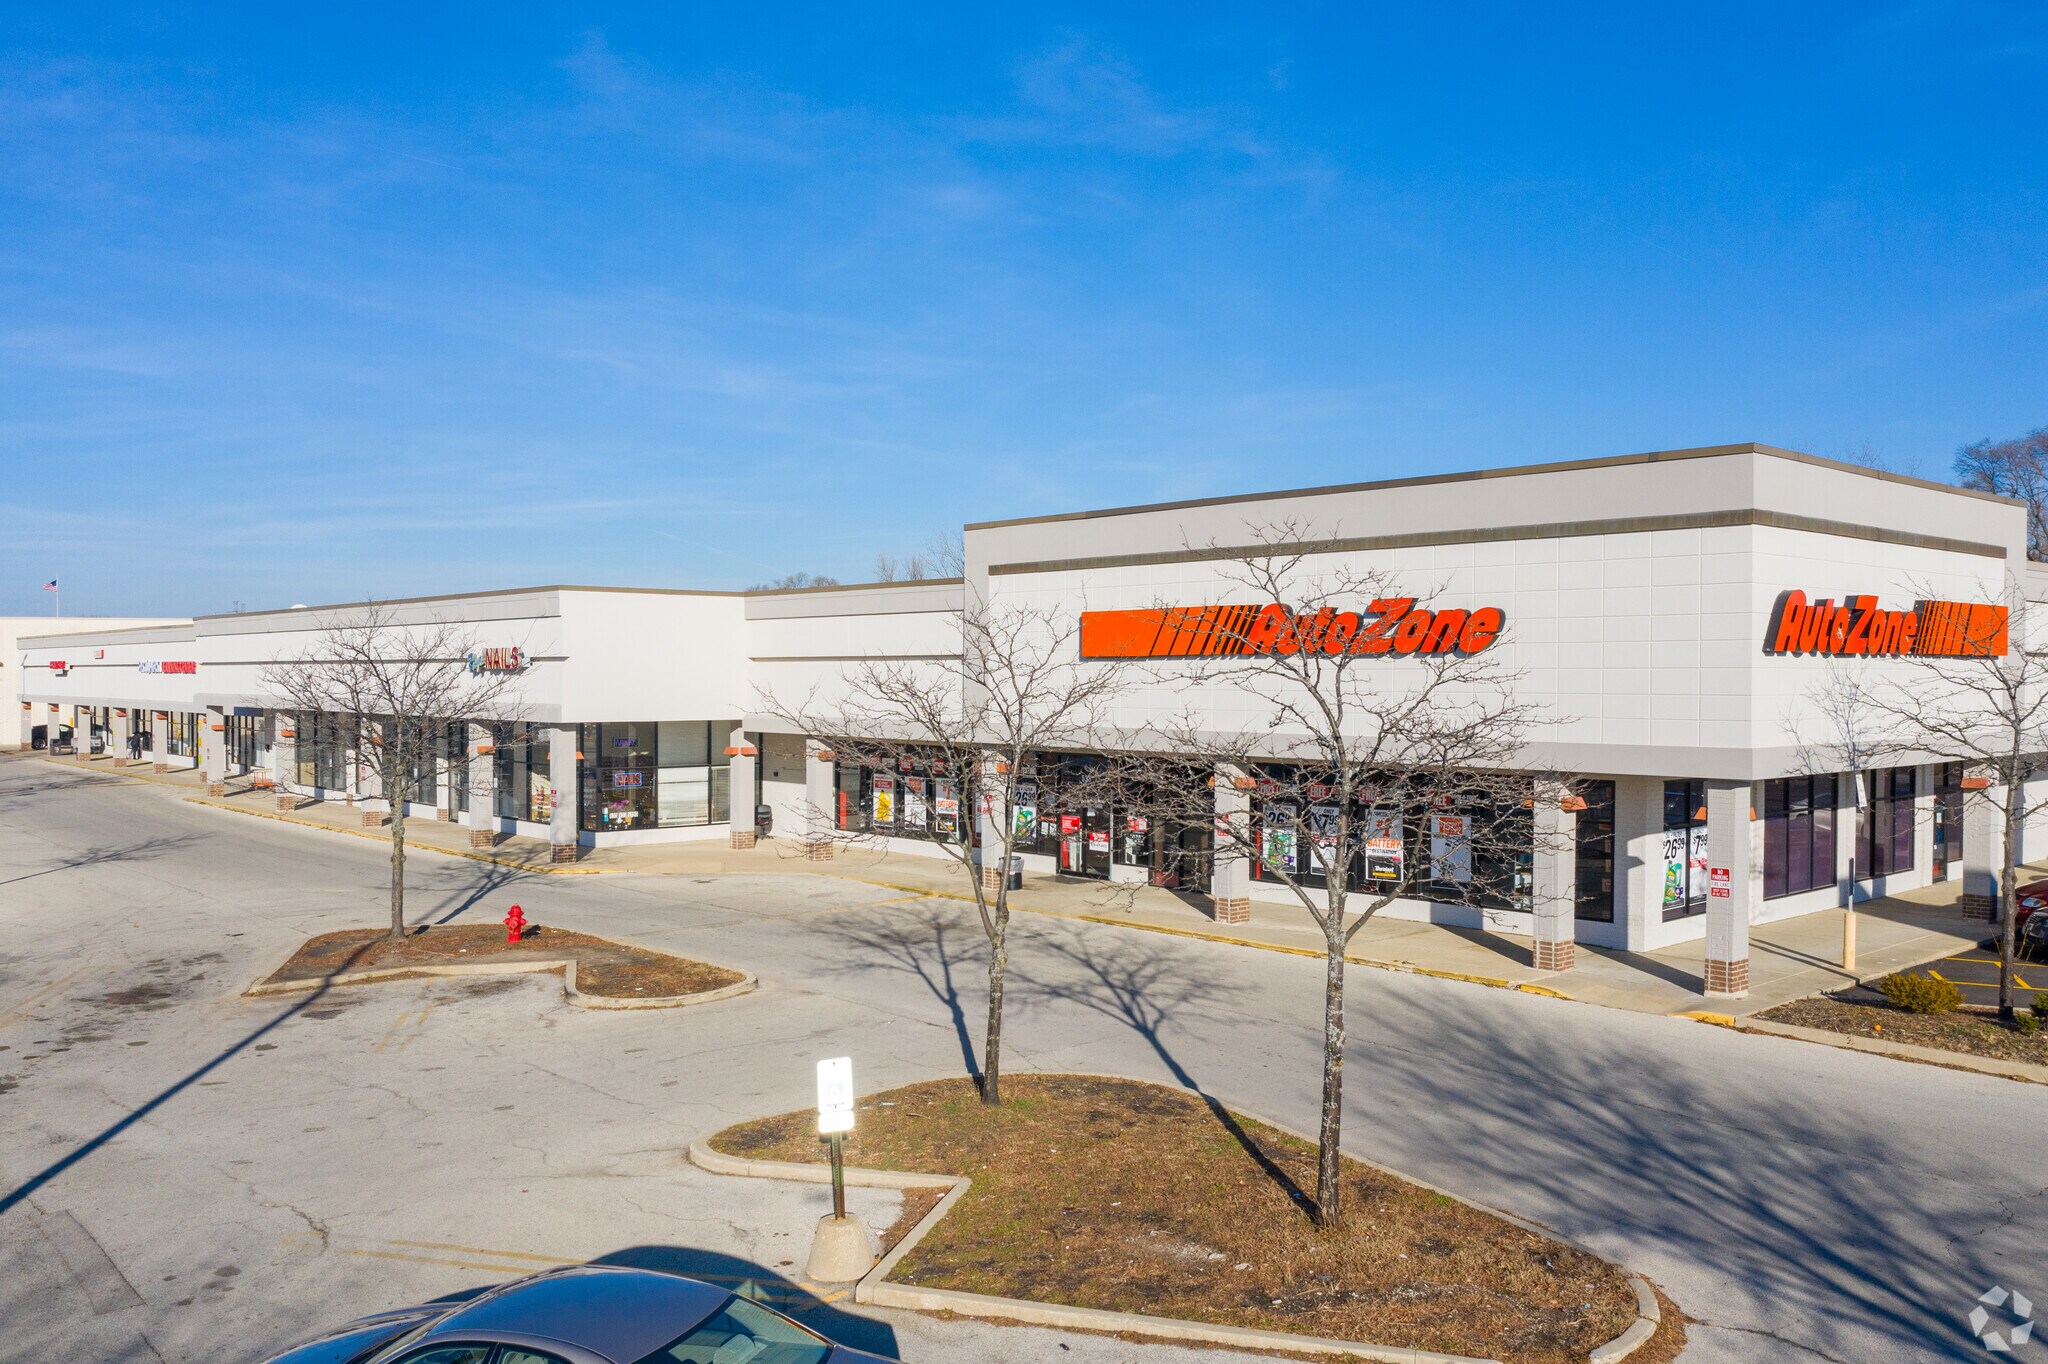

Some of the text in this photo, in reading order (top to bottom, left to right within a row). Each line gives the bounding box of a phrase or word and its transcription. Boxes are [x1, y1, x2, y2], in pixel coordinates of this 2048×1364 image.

[1241, 598, 1503, 655] AutoZone
[1769, 589, 1918, 655] AutoZone
[485, 647, 519, 669] NAILS
[1367, 839, 1401, 849] BATTERY
